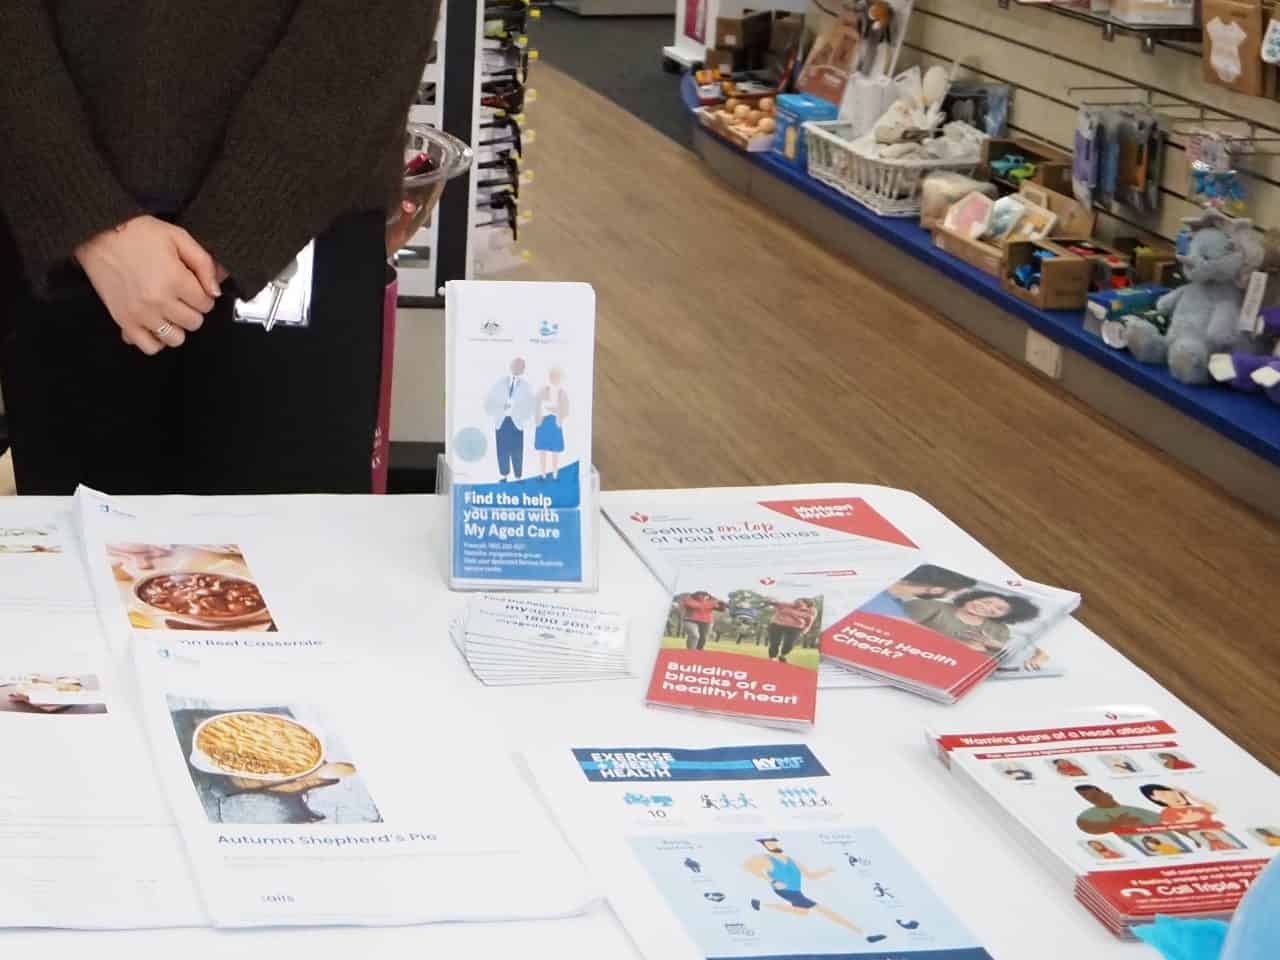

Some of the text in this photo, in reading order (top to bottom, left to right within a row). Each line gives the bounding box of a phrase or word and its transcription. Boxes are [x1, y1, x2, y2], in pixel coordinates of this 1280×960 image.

[464, 491, 552, 508] Find the help
[464, 508, 560, 523] you need with
[464, 524, 560, 540] My Aged Care
[642, 526, 713, 536] Getting
[744, 520, 774, 533] top
[650, 529, 821, 544] of your medicines
[832, 634, 905, 659] Check?
[841, 626, 958, 668] Heart Health
[667, 661, 748, 681] Building
[664, 671, 777, 692] blocks of a
[662, 680, 799, 706] healthy heart
[960, 733, 1017, 746] Warning
[1019, 731, 1050, 744] signs
[1053, 731, 1066, 740] of
[1080, 727, 1115, 738] heart
[1118, 725, 1158, 736] attack
[591, 751, 676, 763] EXERCISE
[601, 767, 673, 779] HEALTH
[648, 809, 667, 819] 10
[217, 831, 438, 848] Autumn Shepherd's Pie
[1156, 881, 1241, 896] Call Triple
